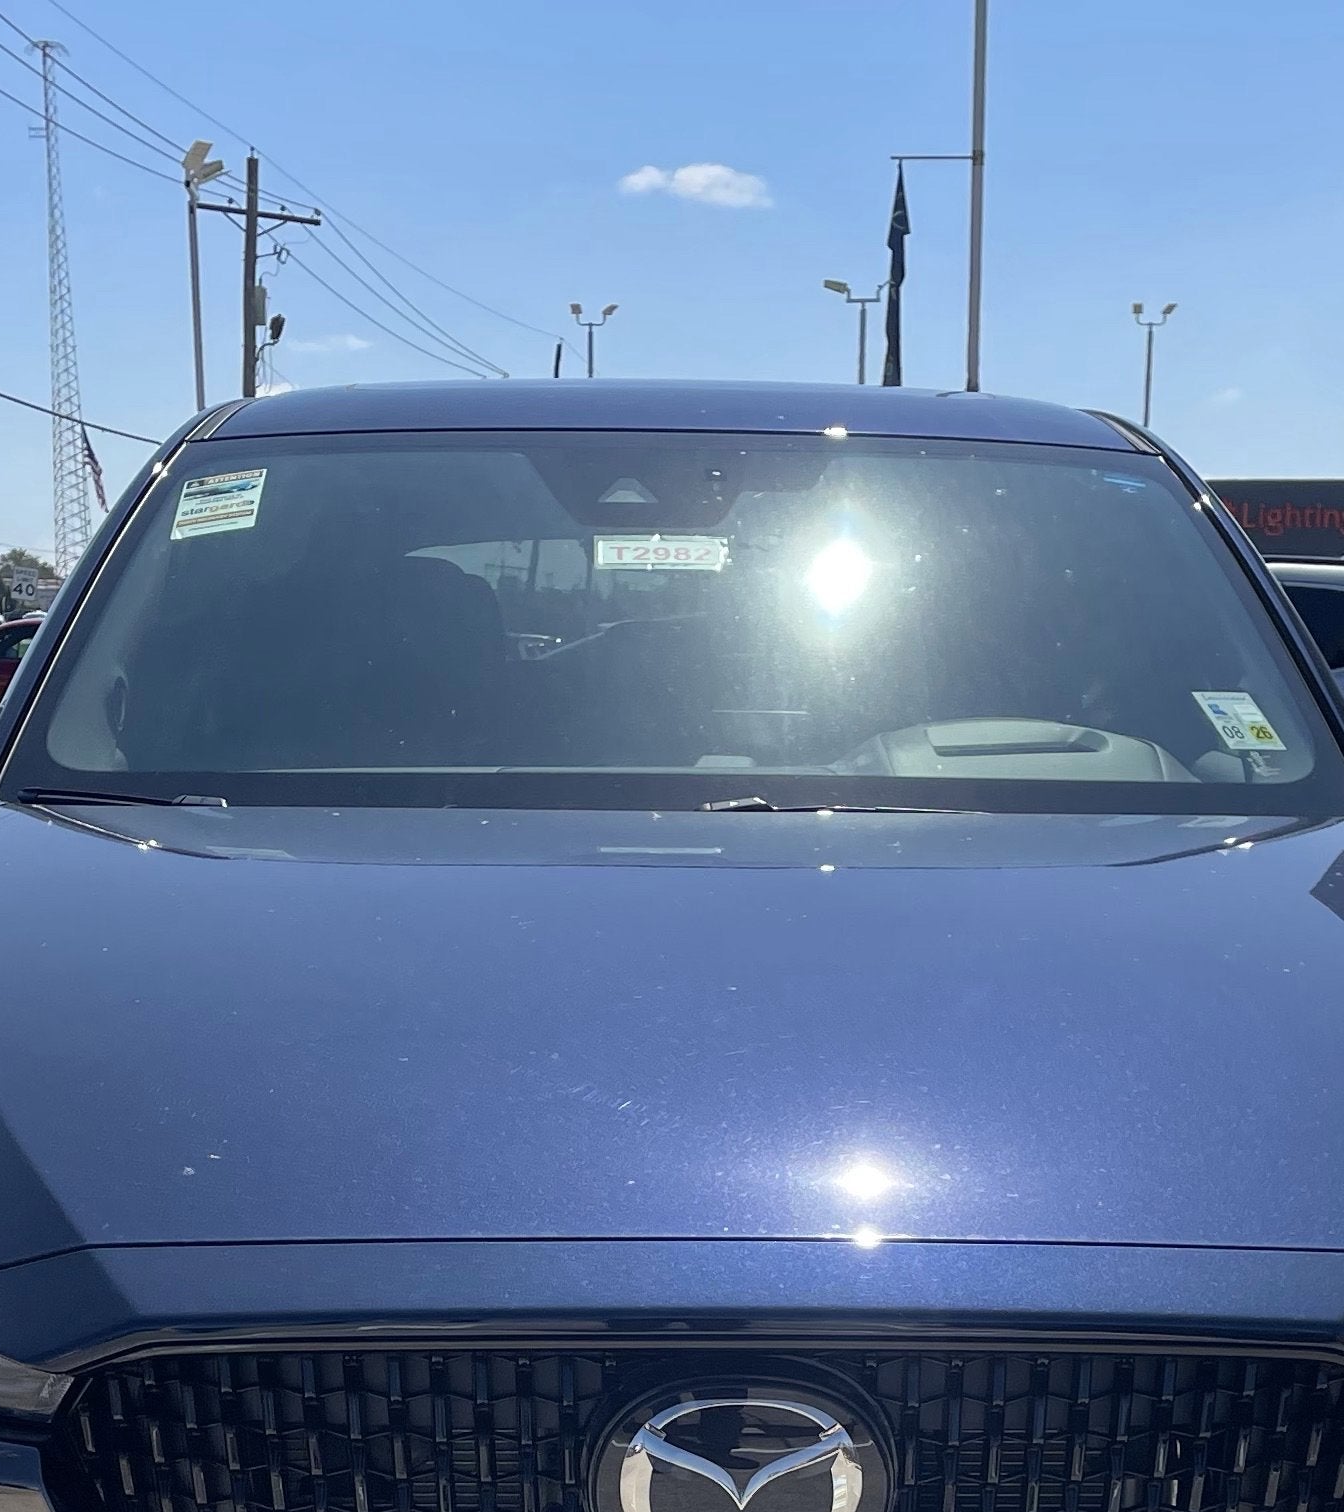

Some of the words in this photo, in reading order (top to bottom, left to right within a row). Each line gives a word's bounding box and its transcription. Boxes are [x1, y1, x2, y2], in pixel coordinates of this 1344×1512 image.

[208, 471, 261, 485] ATTENTION
[609, 546, 712, 562] T2982
[12, 583, 35, 597] 40
[1222, 725, 1245, 739] 08
[1250, 725, 1274, 740] 26
